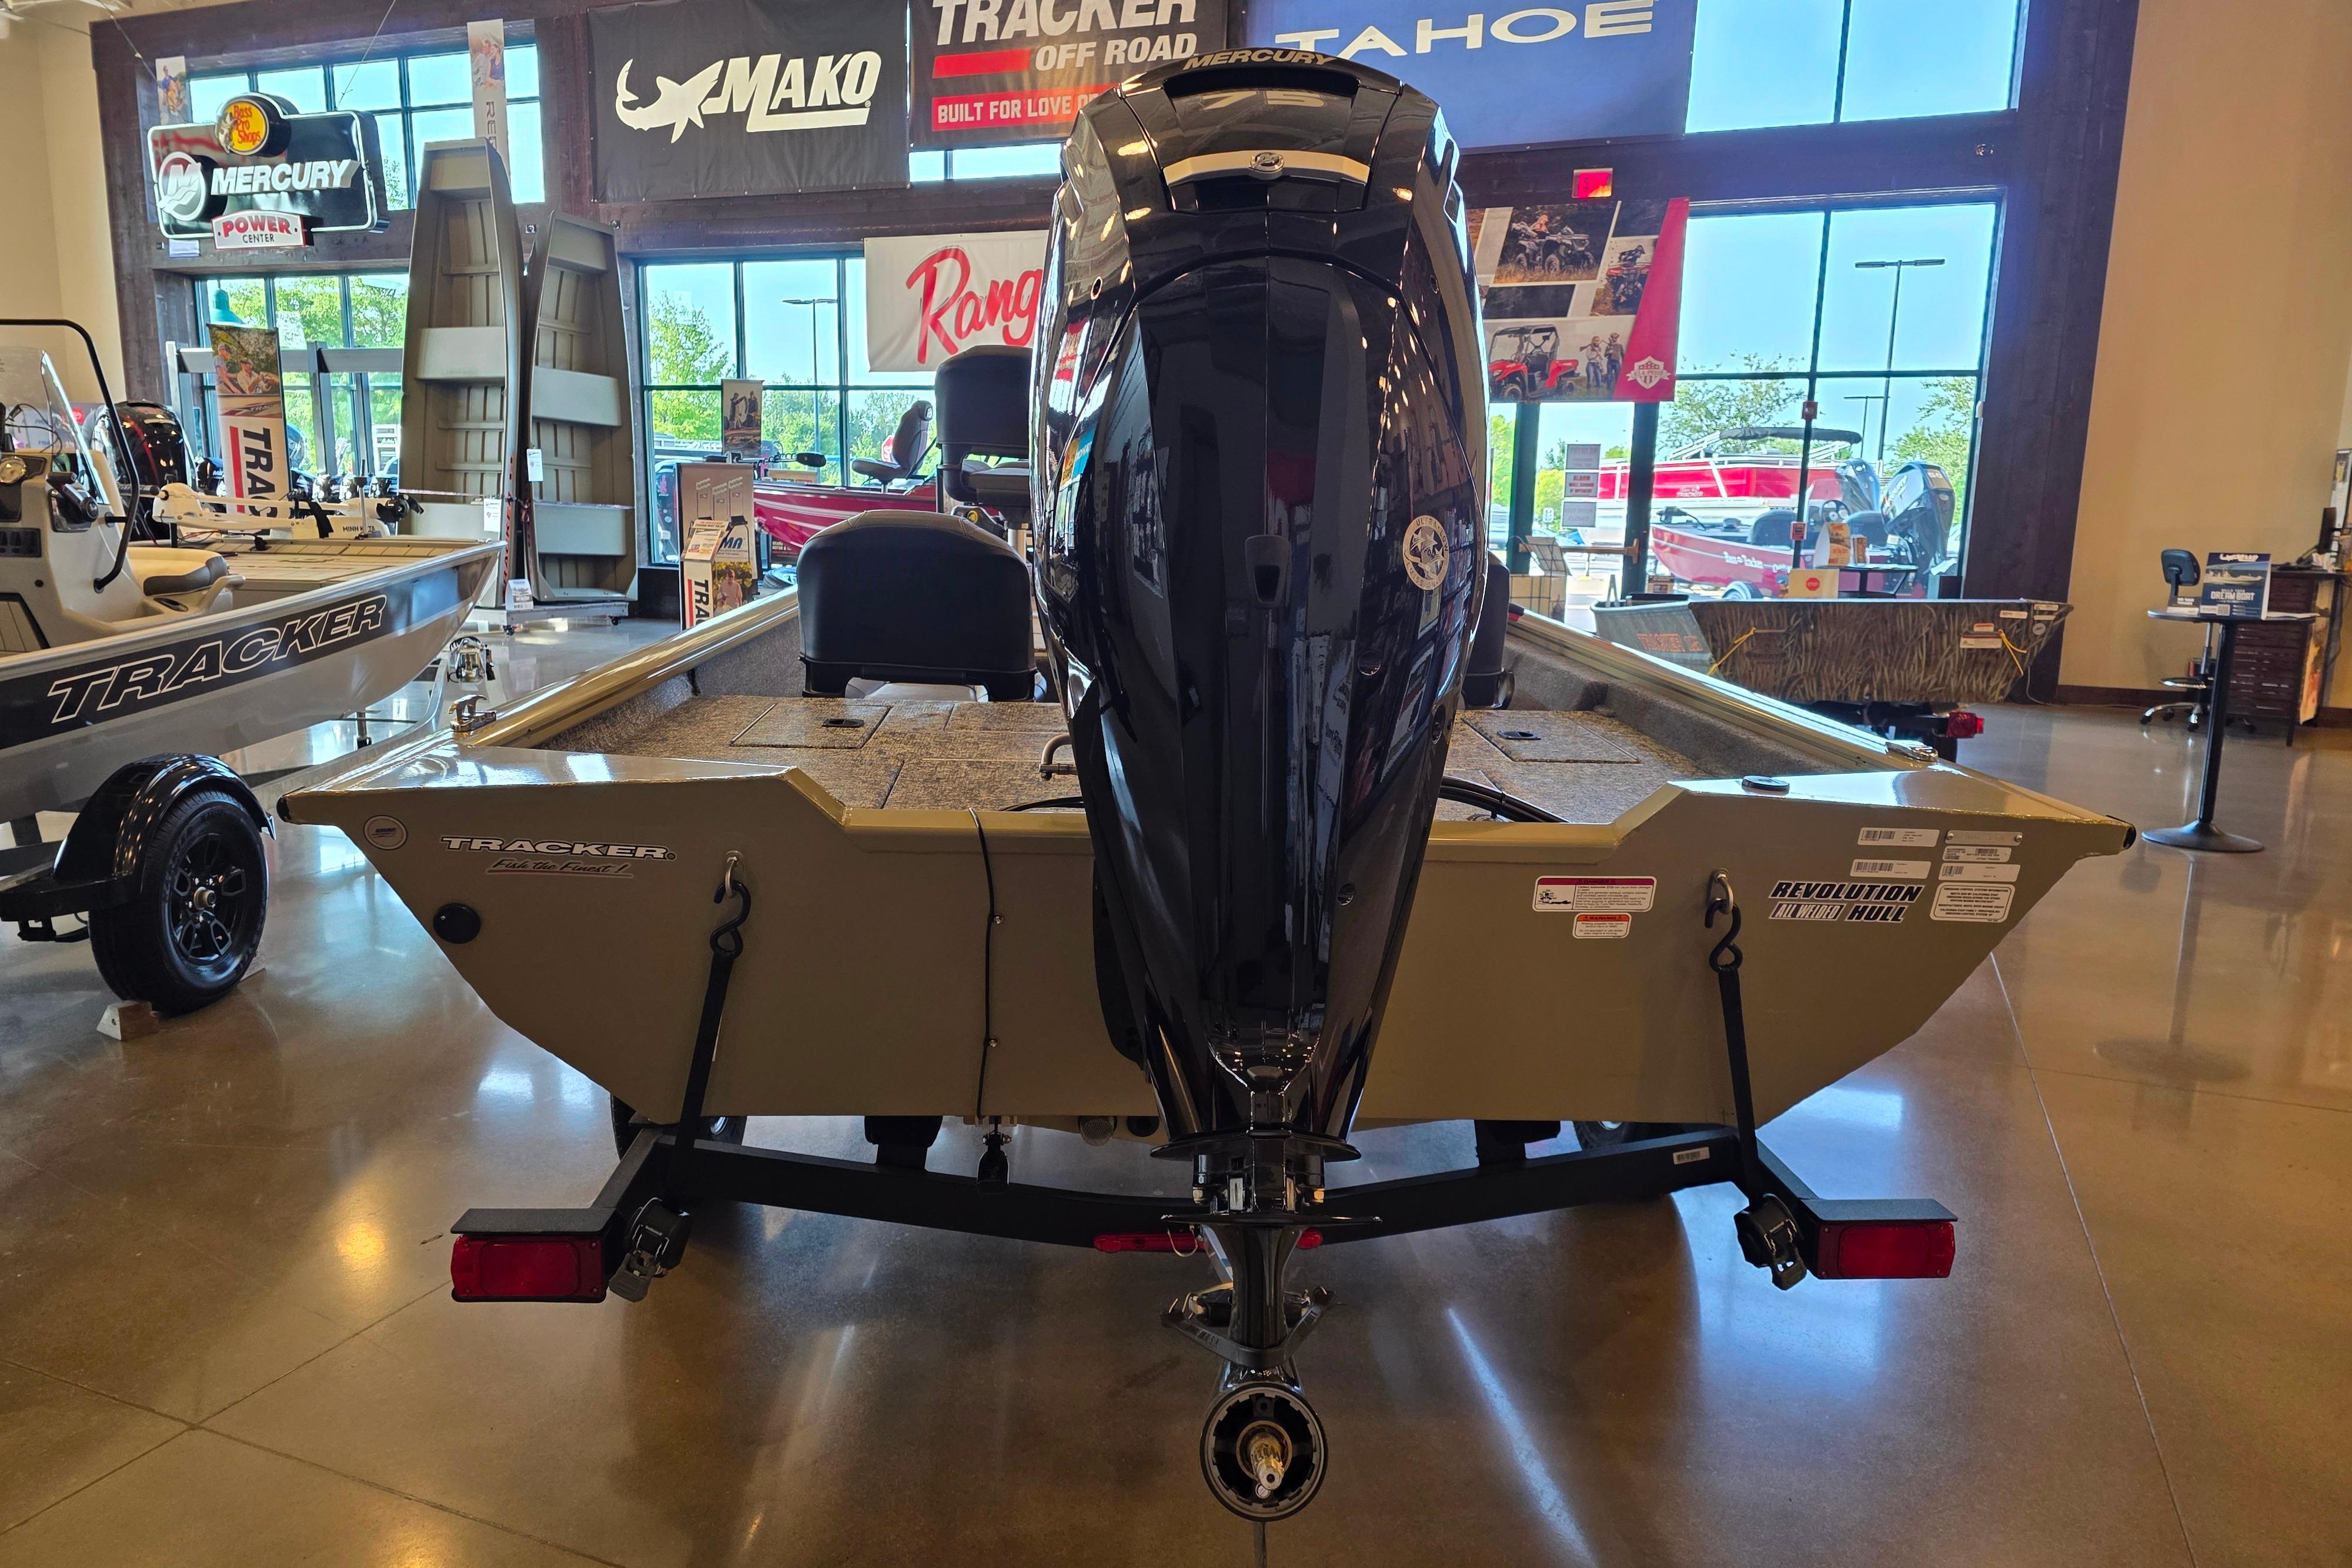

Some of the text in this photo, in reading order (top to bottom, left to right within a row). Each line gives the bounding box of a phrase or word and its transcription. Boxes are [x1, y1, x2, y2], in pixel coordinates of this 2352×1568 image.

[1275, 0, 1653, 60] TAHOE
[1035, 32, 1198, 71] OFF ROAD
[1182, 49, 1336, 71] MERCURY
[709, 51, 882, 132] MAKO
[1202, 91, 1326, 111] 75
[233, 105, 253, 118] Bass
[938, 102, 984, 123] BUILT
[990, 99, 1021, 120] FOR
[1027, 96, 1071, 117] LOVE
[236, 118, 250, 131] Pro
[238, 130, 261, 146] Shops
[211, 159, 356, 195] MERCURY
[222, 215, 292, 238] POWER
[242, 233, 275, 243] CENTER
[48, 594, 388, 724] TRACKER
[441, 836, 669, 860] TRACKER
[492, 859, 532, 869] Fish
[532, 861, 557, 871] the
[559, 861, 612, 872] Finest
[1769, 881, 1924, 902] REVOLUTION
[1775, 904, 1908, 922] ALL WELDED HULL
